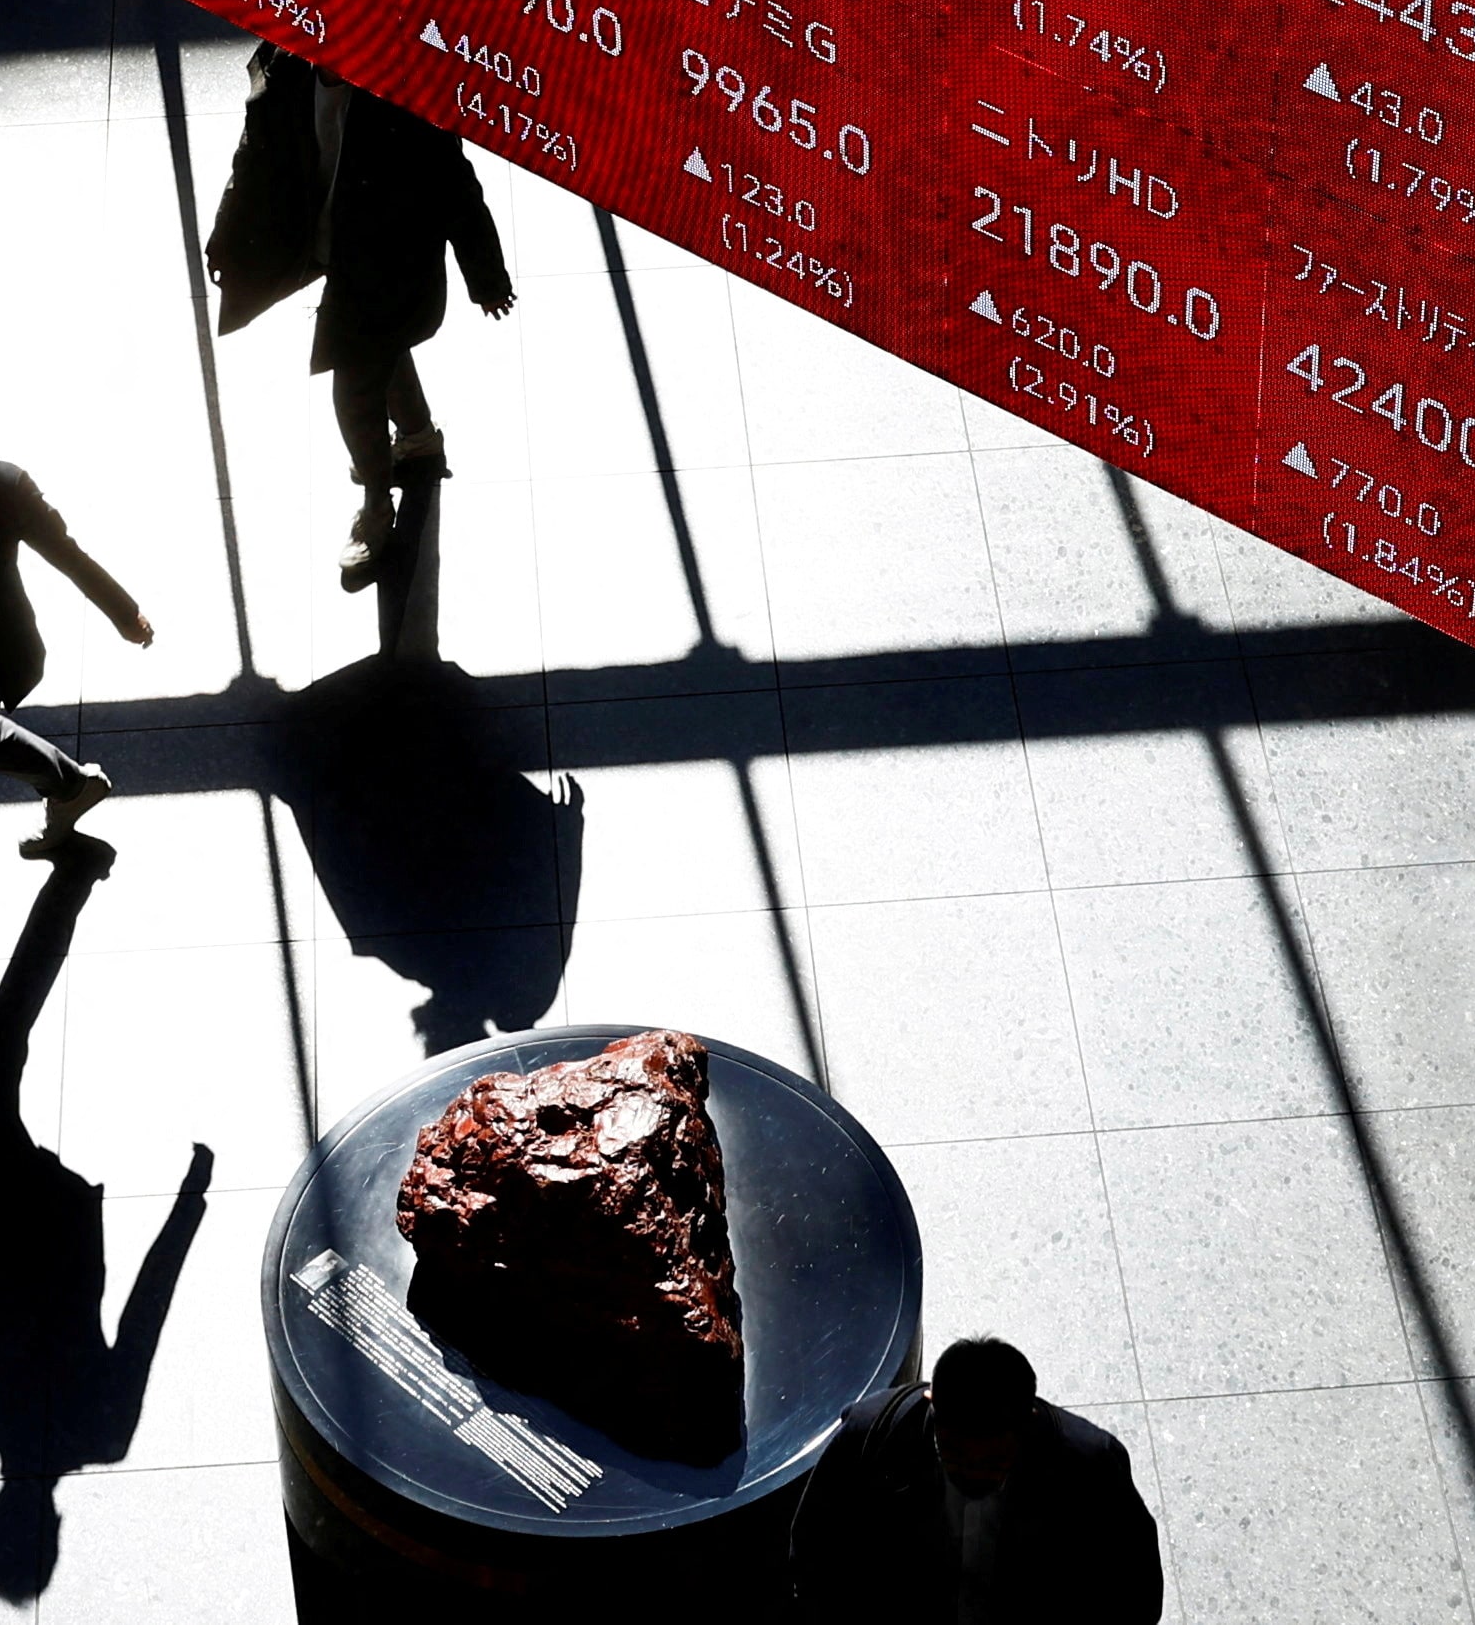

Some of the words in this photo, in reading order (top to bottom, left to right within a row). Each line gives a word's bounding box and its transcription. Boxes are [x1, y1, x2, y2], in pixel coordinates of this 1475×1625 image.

[681, 48, 870, 175] 9965.0
[971, 100, 1179, 219] ニトリHD
[971, 185, 1220, 340] 21890.0
[1332, 459, 1441, 535] 770.0
